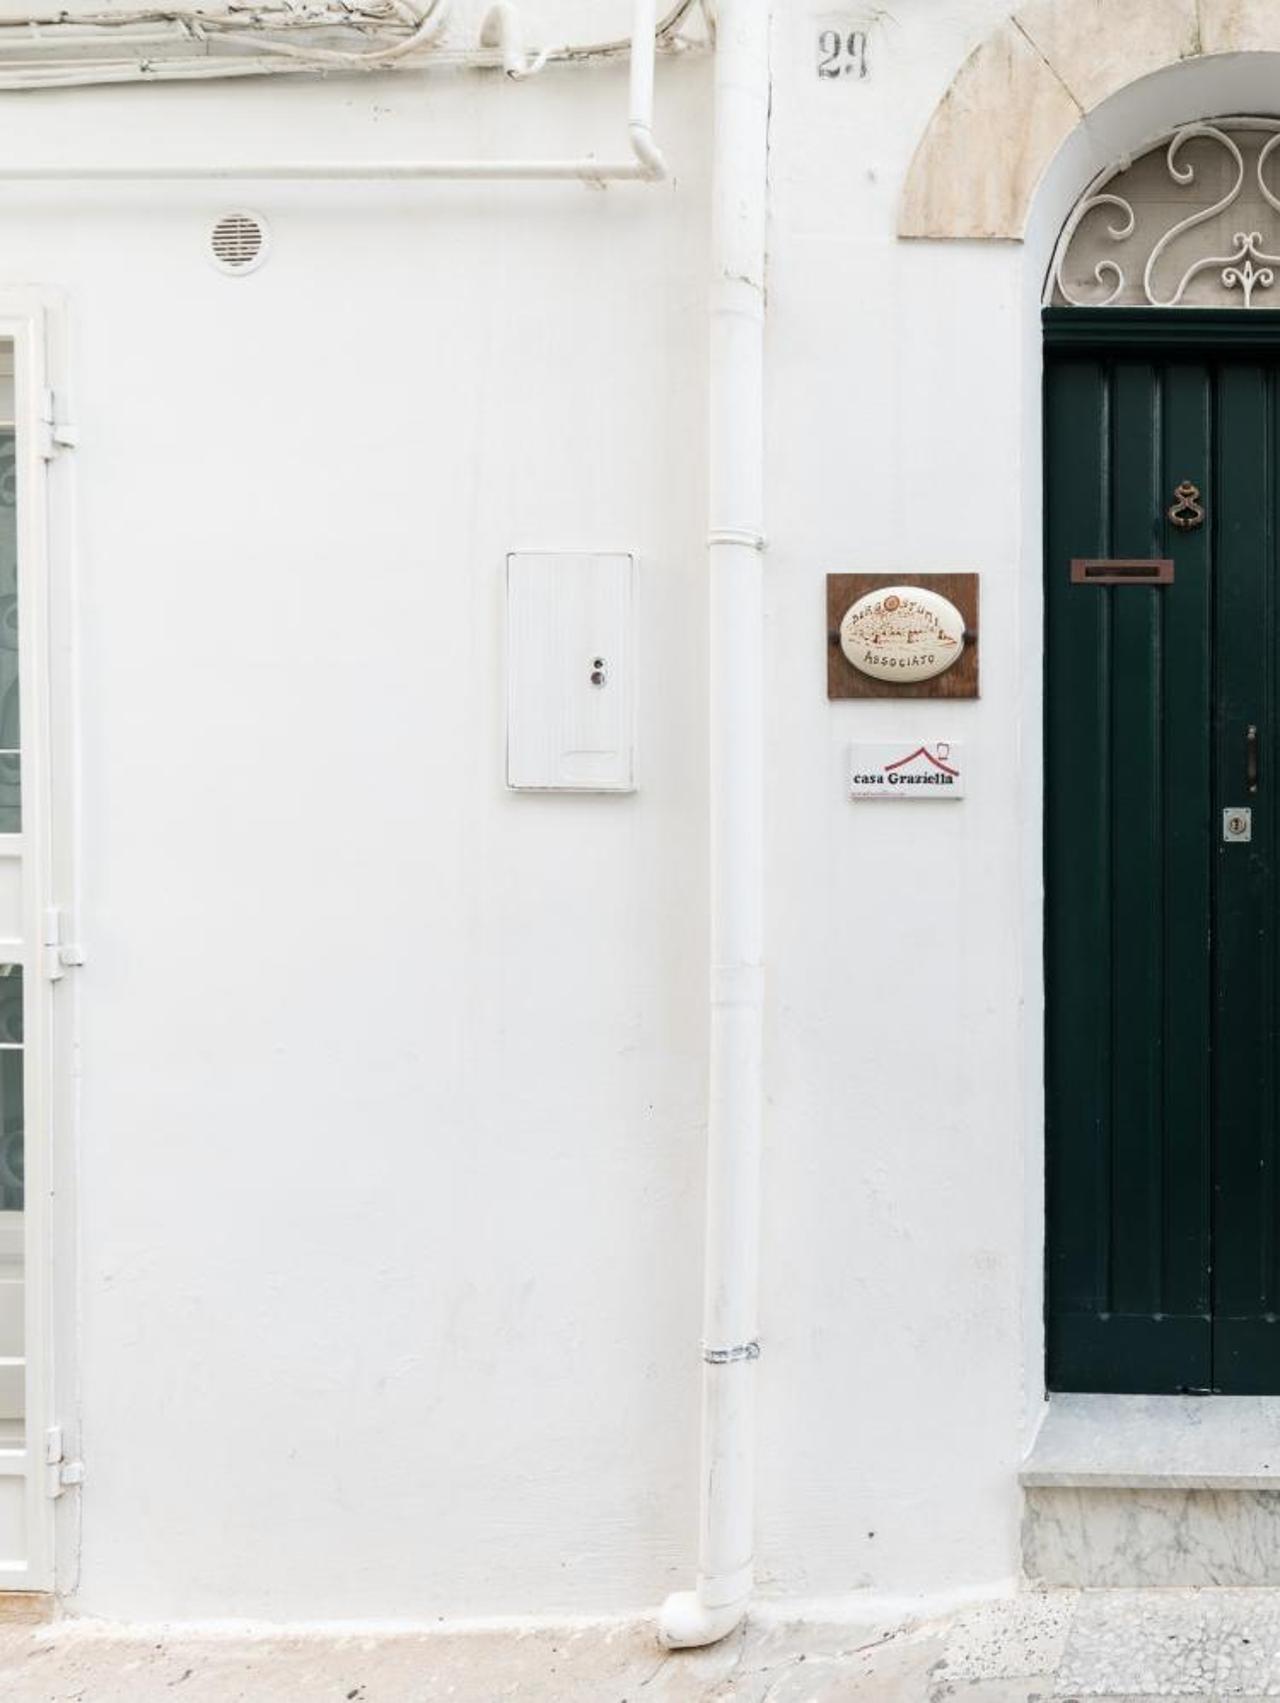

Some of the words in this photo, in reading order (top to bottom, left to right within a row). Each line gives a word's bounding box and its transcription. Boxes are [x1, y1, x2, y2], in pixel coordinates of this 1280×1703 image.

[818, 30, 867, 79] 29
[853, 773, 884, 784] casa
[888, 771, 953, 784] Graziella
